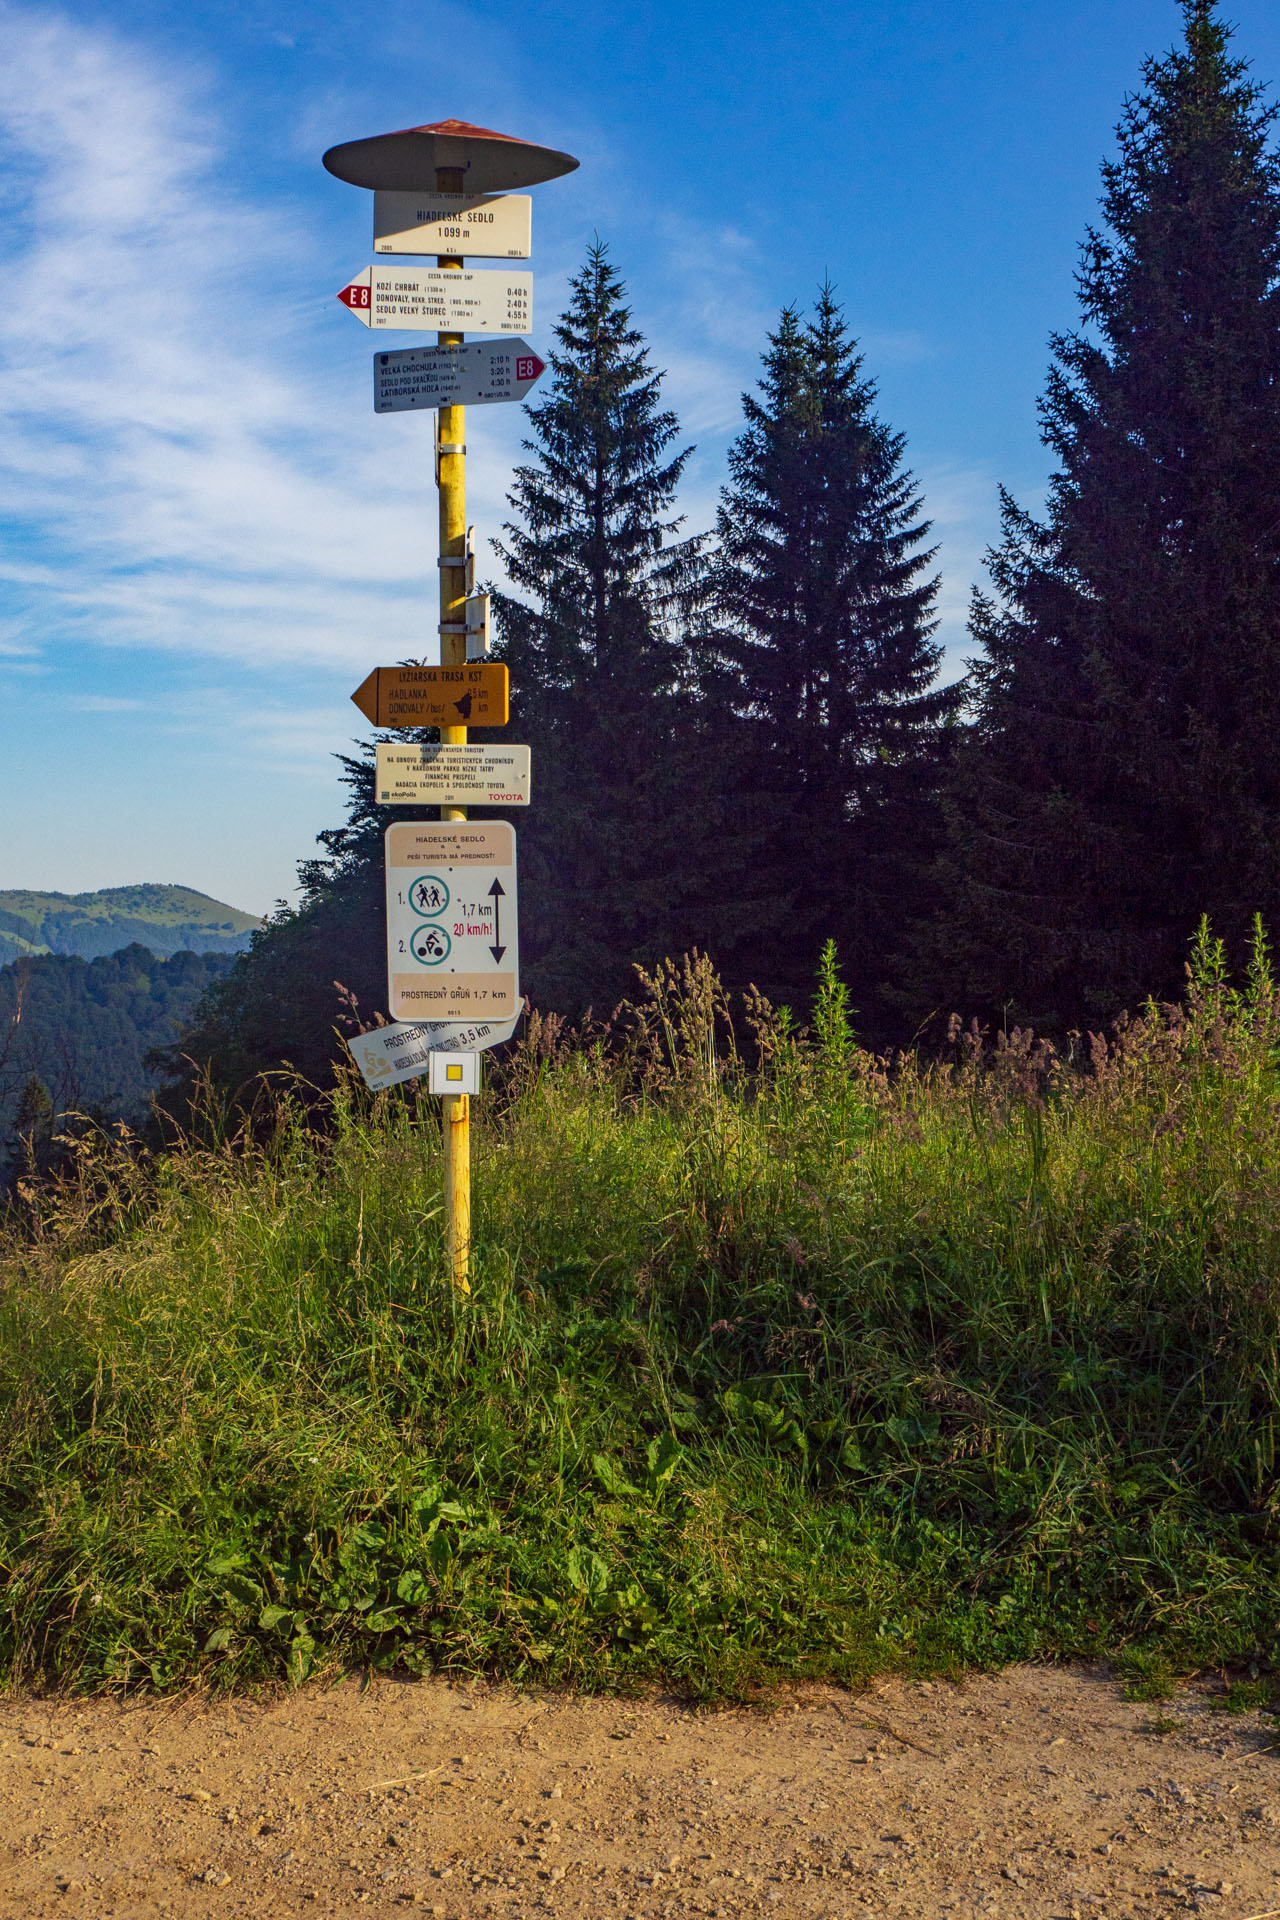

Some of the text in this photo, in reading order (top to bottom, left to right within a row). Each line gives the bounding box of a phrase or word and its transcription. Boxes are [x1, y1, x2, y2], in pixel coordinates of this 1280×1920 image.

[467, 212, 494, 224] SEDLO
[463, 230, 470, 238] m
[376, 281, 392, 291] KOZÍ
[523, 300, 528, 308] h
[376, 305, 397, 314] SEDLO
[422, 306, 446, 316] ŠTUREC
[523, 311, 527, 319] h
[505, 355, 510, 363] h
[505, 366, 510, 374] h
[380, 378, 399, 388] SEDLO
[505, 378, 511, 386] h
[398, 670, 437, 682] LYŽIARSKA
[441, 671, 464, 682] TRASA
[478, 688, 489, 699] km
[478, 703, 489, 712] km
[488, 793, 524, 801] TOYOTA
[397, 891, 406, 905] 1.
[462, 903, 492, 918] 1,7 km
[453, 922, 493, 936] 20 km/h!
[398, 939, 407, 953] 2.
[473, 990, 488, 1000] 1,7
[492, 990, 507, 999] km
[459, 1029, 476, 1045] 3,5
[476, 1024, 492, 1038] km
